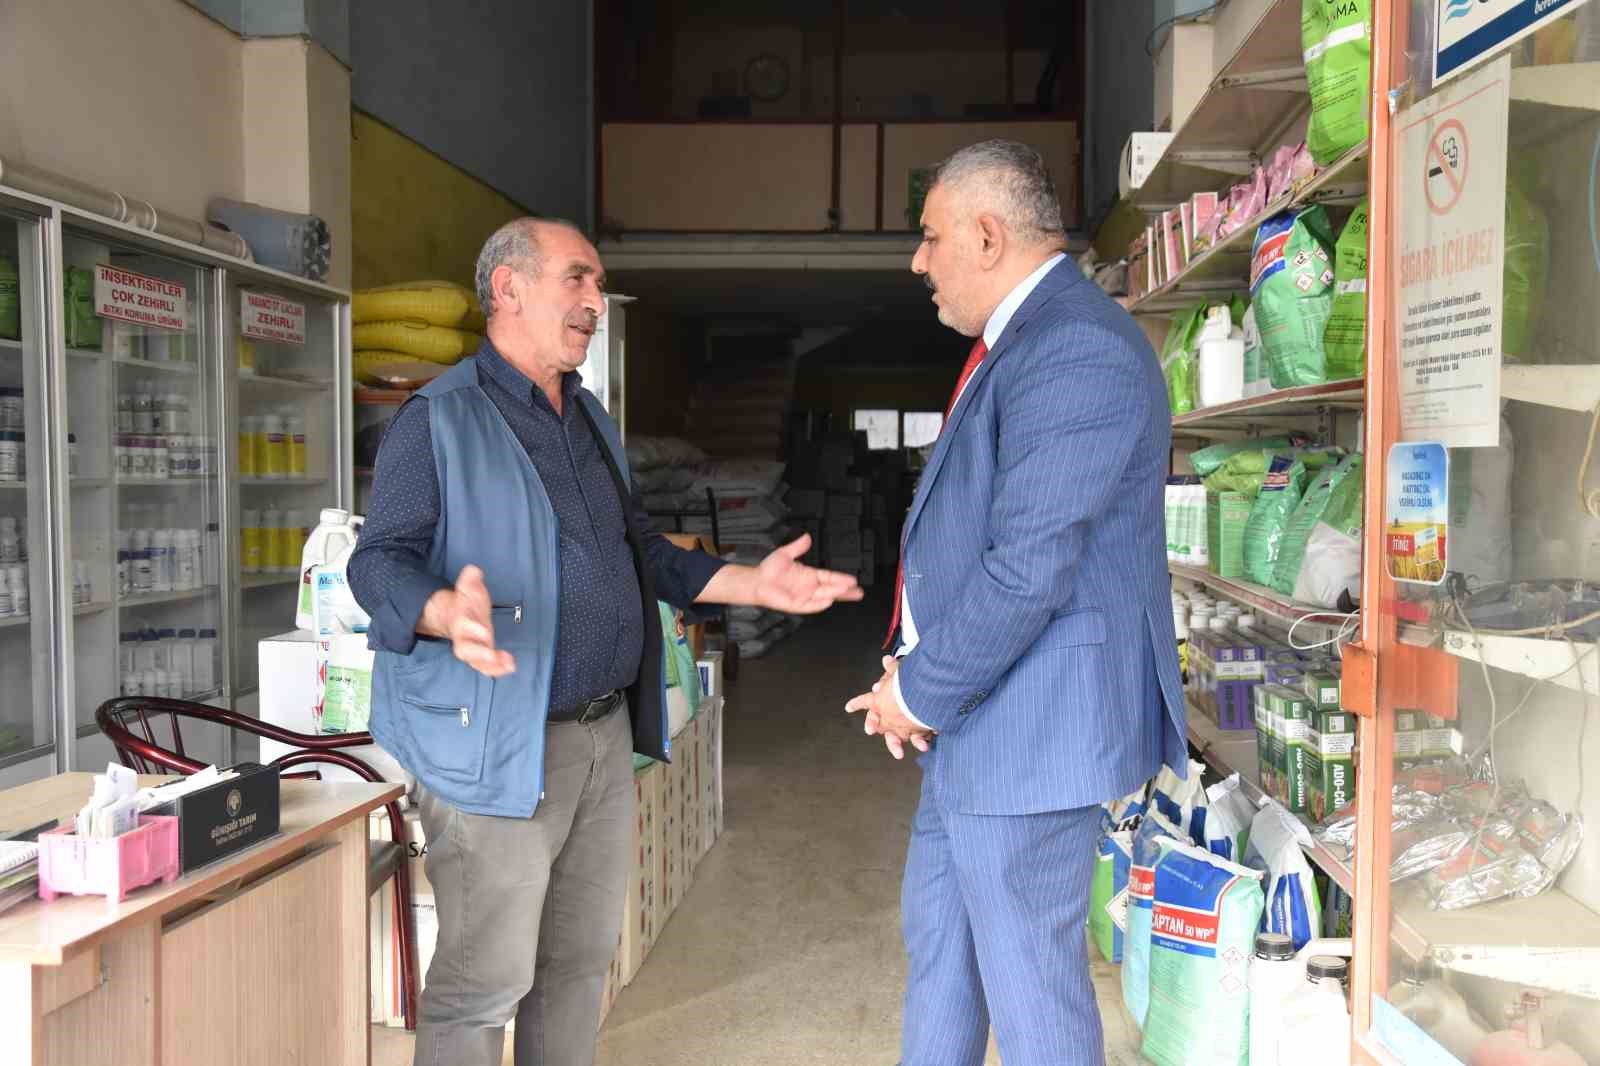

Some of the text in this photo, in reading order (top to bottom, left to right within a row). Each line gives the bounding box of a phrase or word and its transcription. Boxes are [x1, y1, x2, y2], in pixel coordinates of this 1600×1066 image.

[101, 268, 182, 298] İNSEKTİSİTLER
[112, 289, 175, 313] ÇOK ZEHİRLİ
[256, 312, 295, 329] ZEHİRLİ
[1185, 926, 1194, 937] 50
